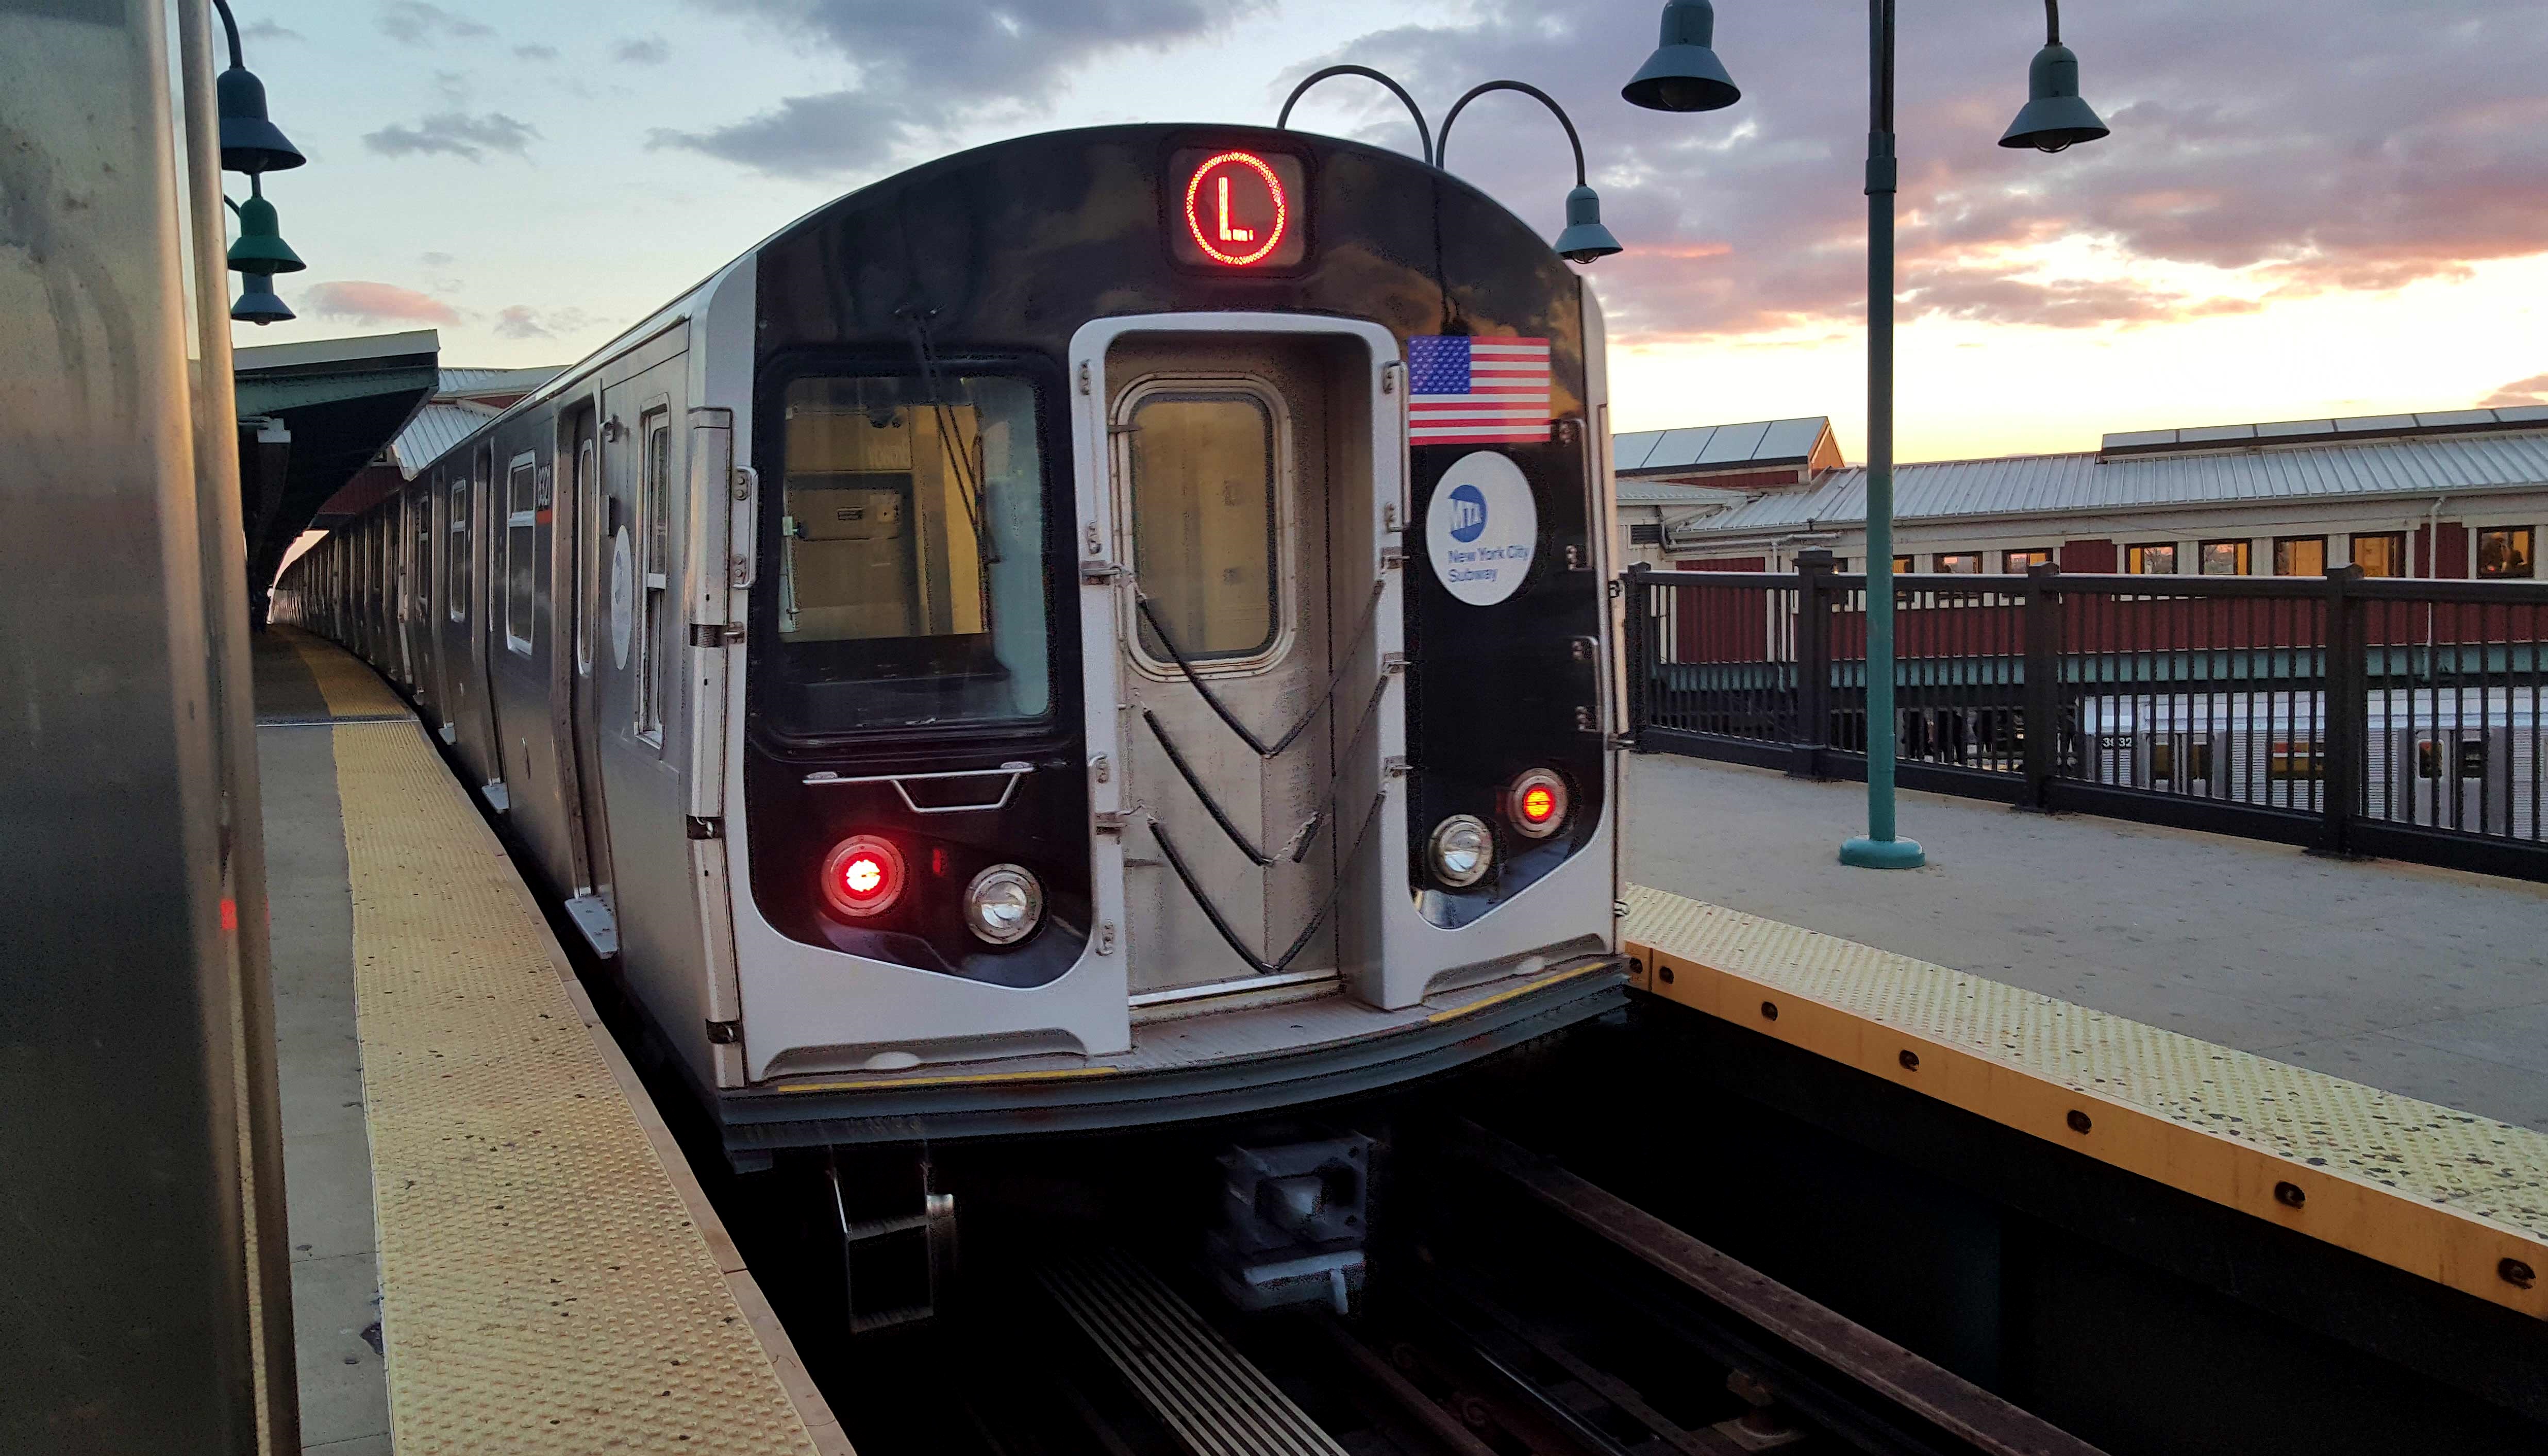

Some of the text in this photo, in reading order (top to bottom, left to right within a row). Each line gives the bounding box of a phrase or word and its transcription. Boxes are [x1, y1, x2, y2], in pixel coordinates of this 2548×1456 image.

[1218, 177, 1254, 241] L
[1448, 498, 1482, 531] MTA
[1448, 545, 1529, 564] New York City
[1448, 568, 1498, 582] Subway
